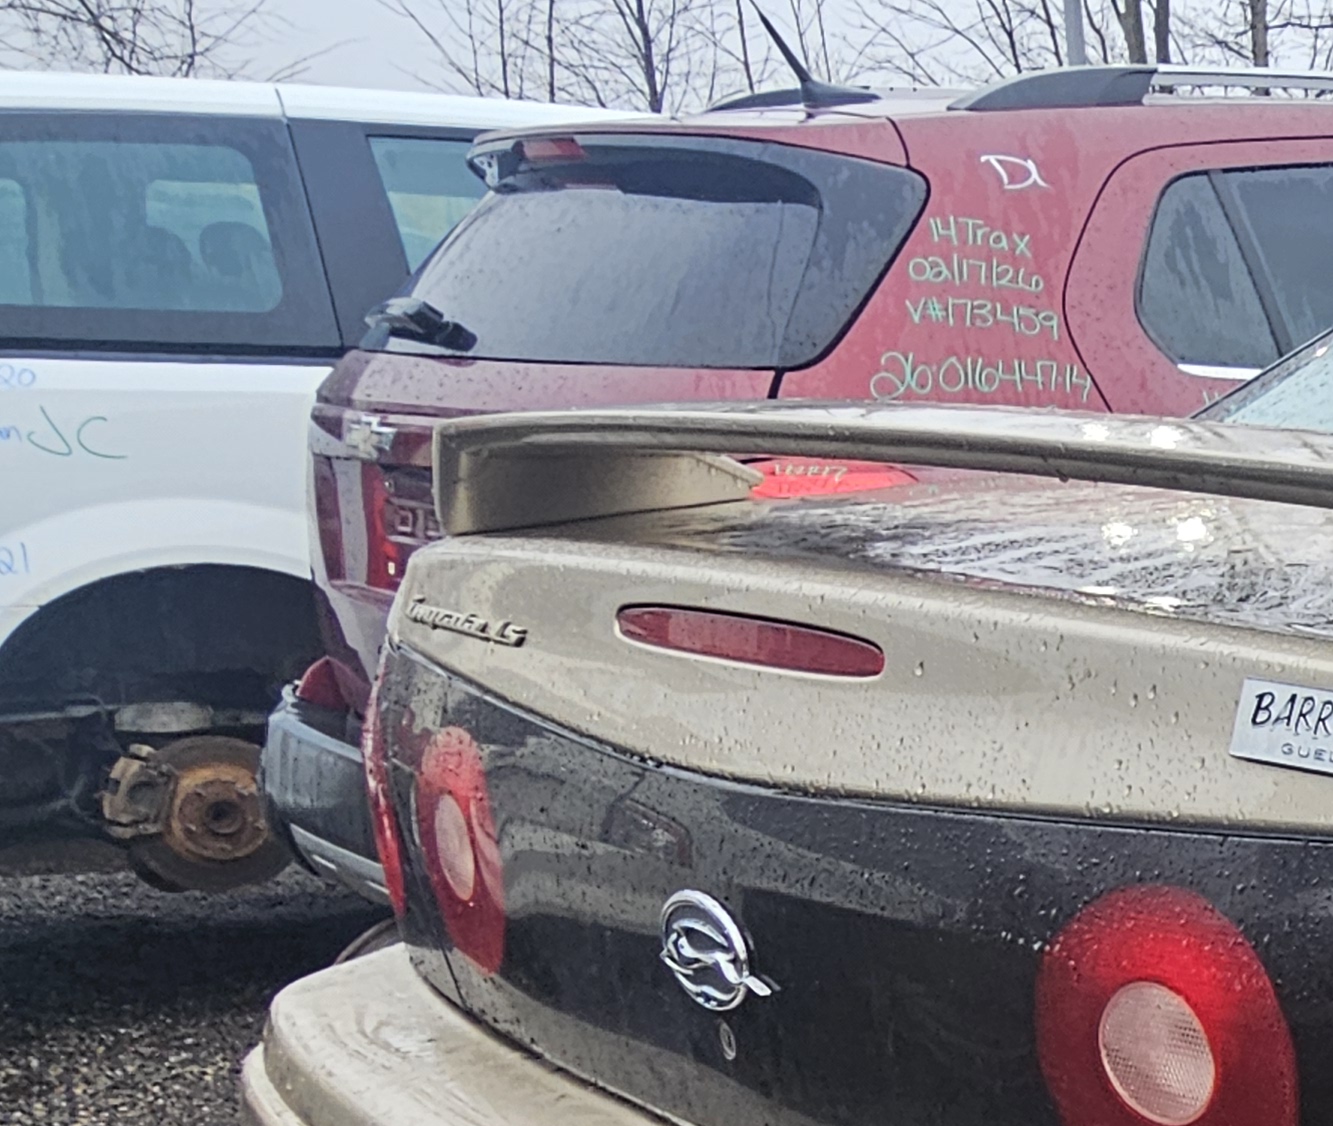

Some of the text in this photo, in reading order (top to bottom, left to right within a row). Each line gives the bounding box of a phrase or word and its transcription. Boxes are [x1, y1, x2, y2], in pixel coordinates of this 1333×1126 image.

[959, 215, 1034, 259] Trax
[906, 252, 1045, 294] 02/17/26
[904, 294, 1060, 341] V#173459
[27, 404, 129, 460] JC
